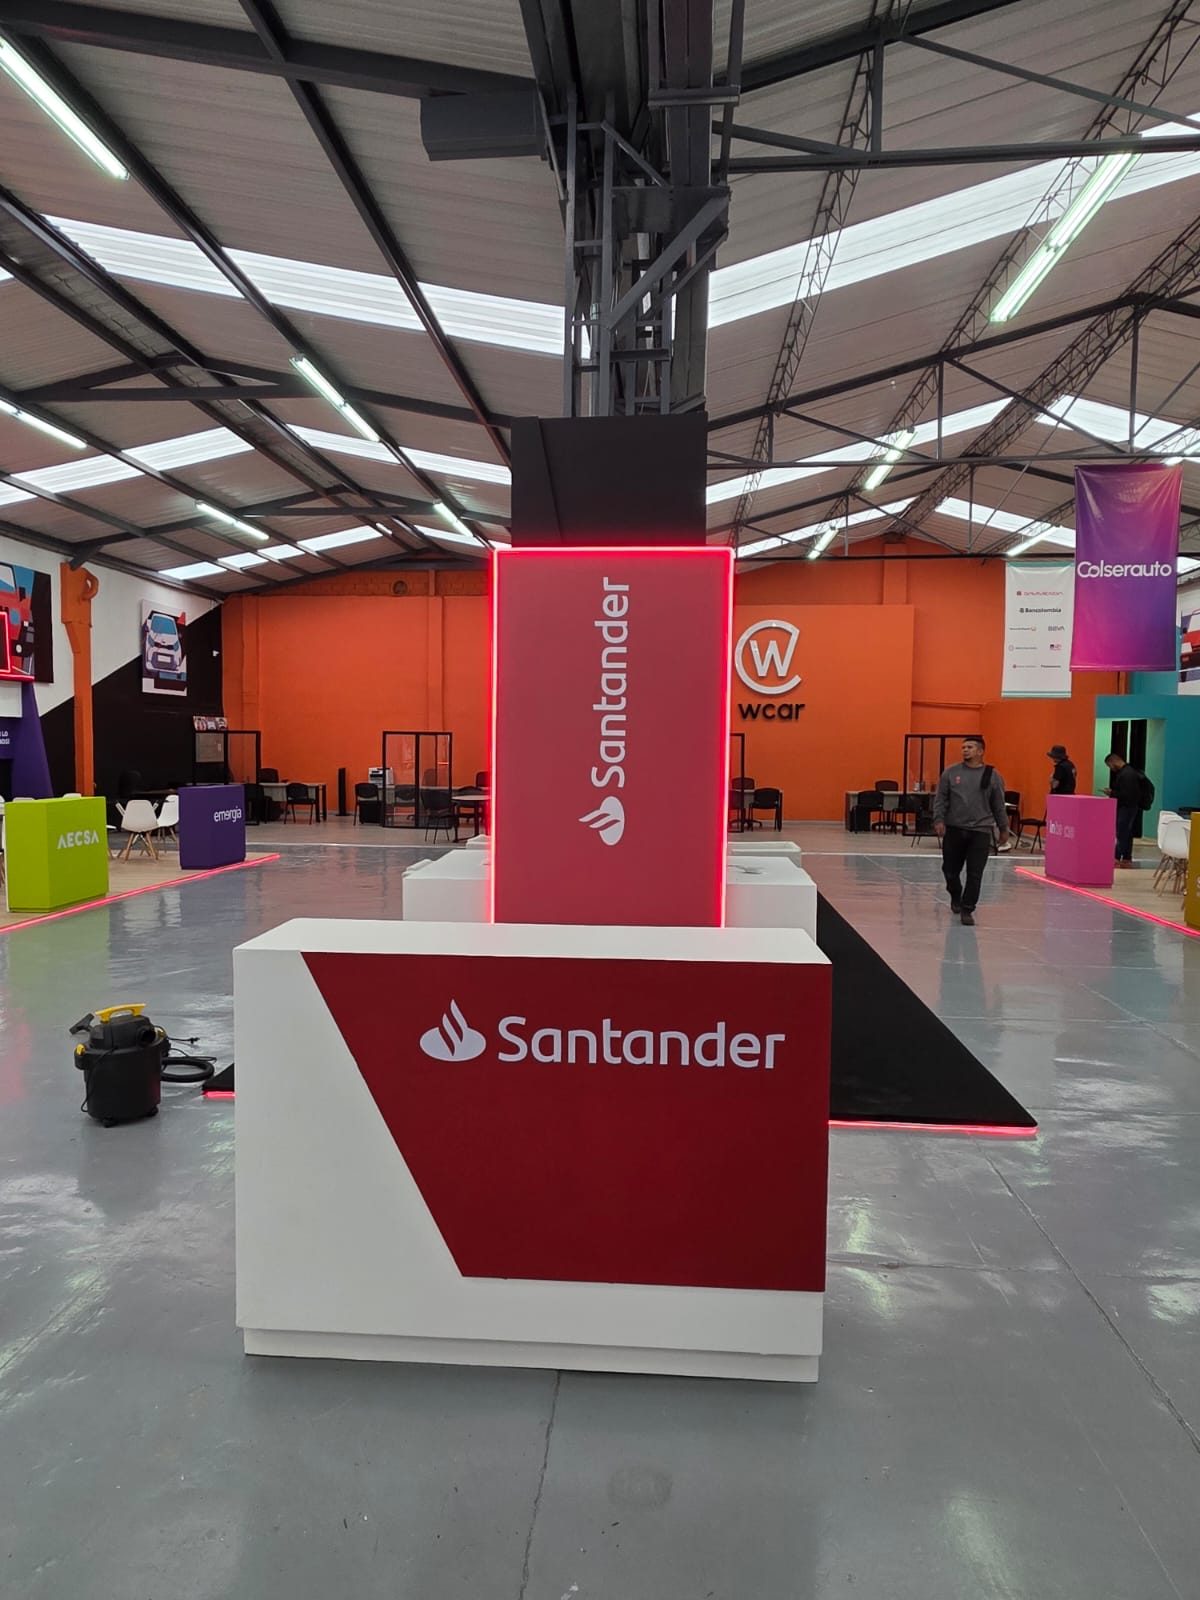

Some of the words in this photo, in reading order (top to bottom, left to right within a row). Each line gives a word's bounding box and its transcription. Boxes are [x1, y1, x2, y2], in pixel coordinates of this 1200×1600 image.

[1077, 560, 1172, 578] Colserauto
[591, 576, 629, 788] Santander
[738, 703, 805, 720] wcar
[57, 830, 99, 850] AECSA
[498, 1015, 786, 1069] Santander
